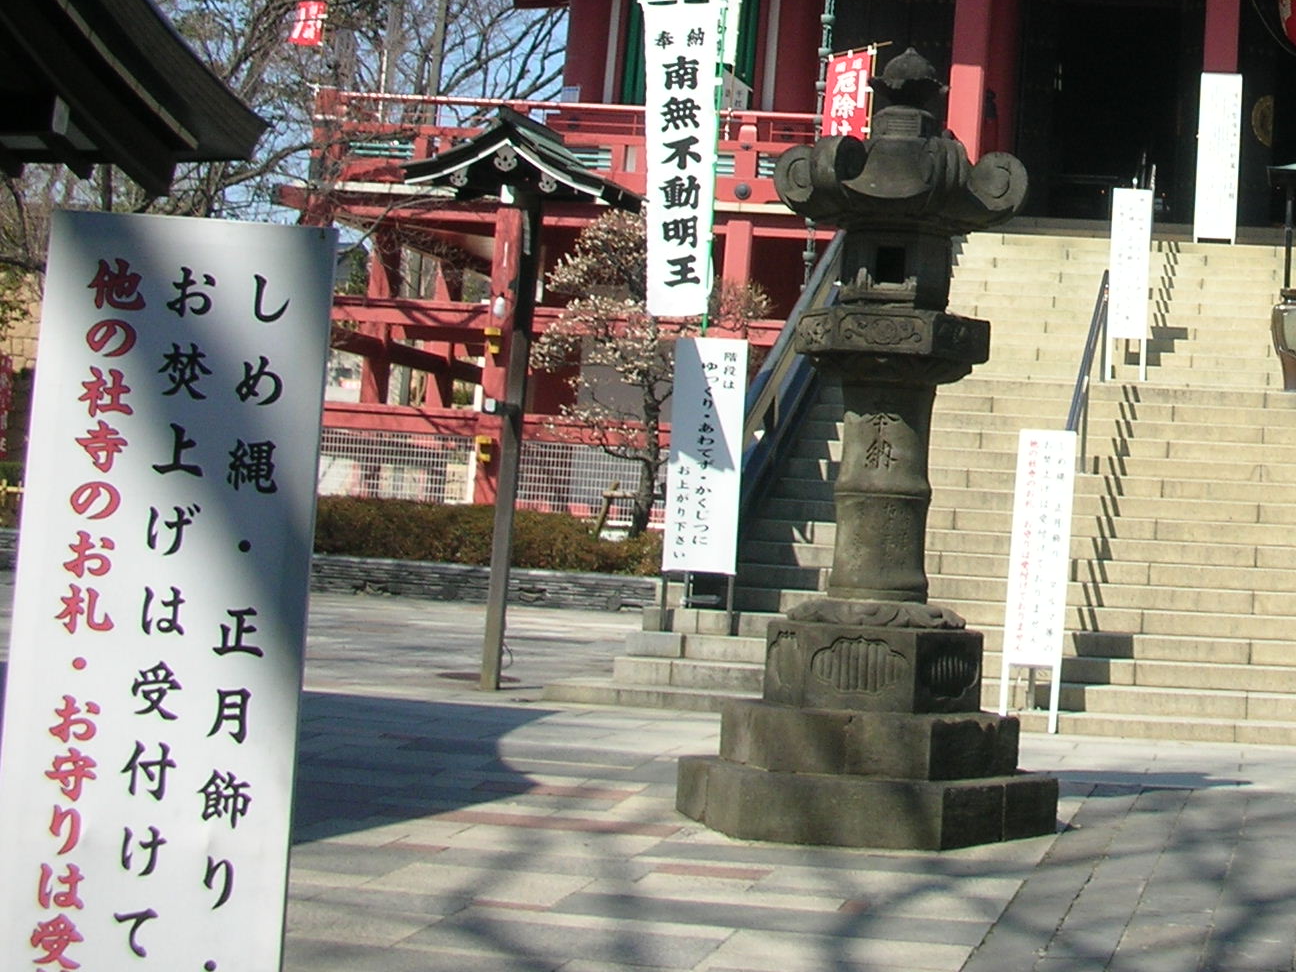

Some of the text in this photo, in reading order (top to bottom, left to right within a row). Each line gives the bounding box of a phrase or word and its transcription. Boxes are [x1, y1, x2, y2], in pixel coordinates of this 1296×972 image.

[654, 27, 706, 49] 奉納
[659, 56, 702, 288] 南無不動明王
[723, 351, 738, 390] 階段は
[674, 465, 690, 559] お上がり下さい
[30, 257, 147, 972] 他の社寺のお札・お守りは受
[112, 265, 217, 958] お焚上げは受付けて
